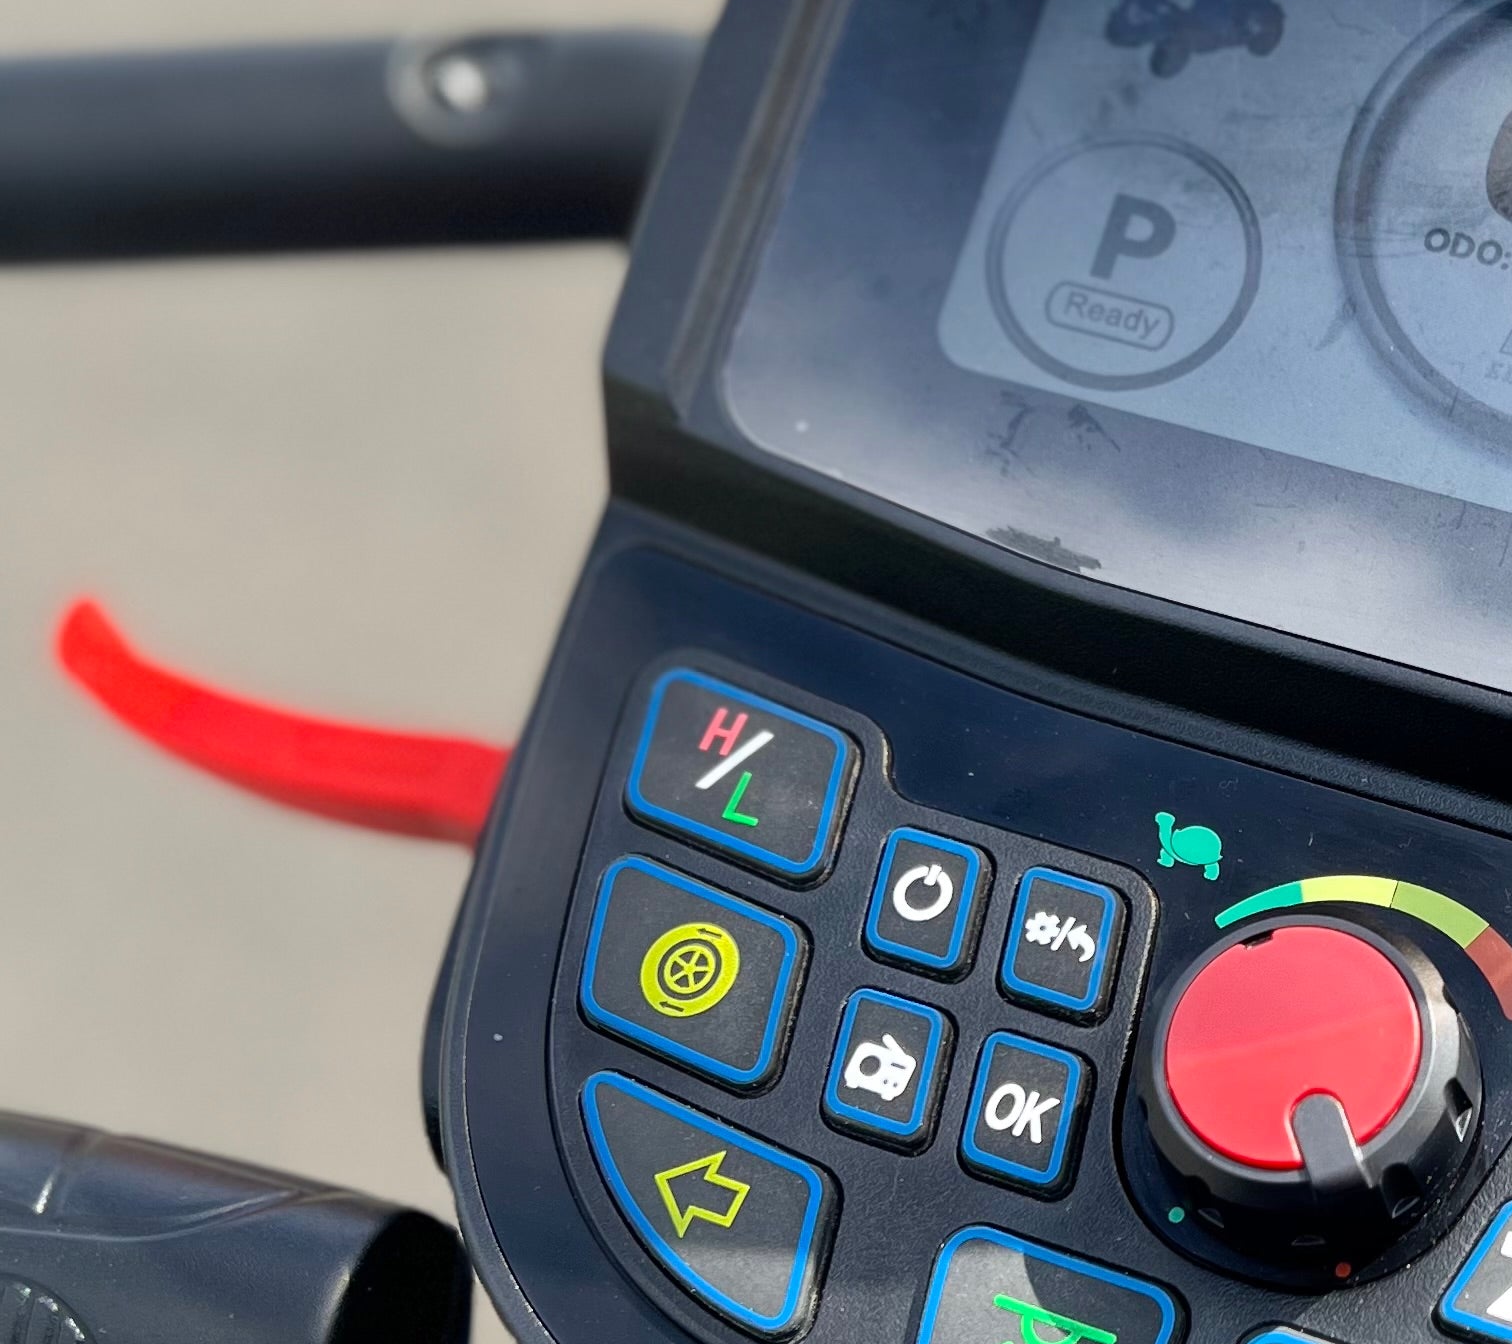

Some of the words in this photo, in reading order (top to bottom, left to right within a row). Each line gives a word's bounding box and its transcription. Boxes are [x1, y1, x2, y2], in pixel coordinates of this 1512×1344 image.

[1090, 193, 1176, 280] P
[1424, 227, 1511, 270] ODO:
[1064, 291, 1160, 340] Ready
[984, 1083, 1060, 1144] OK
